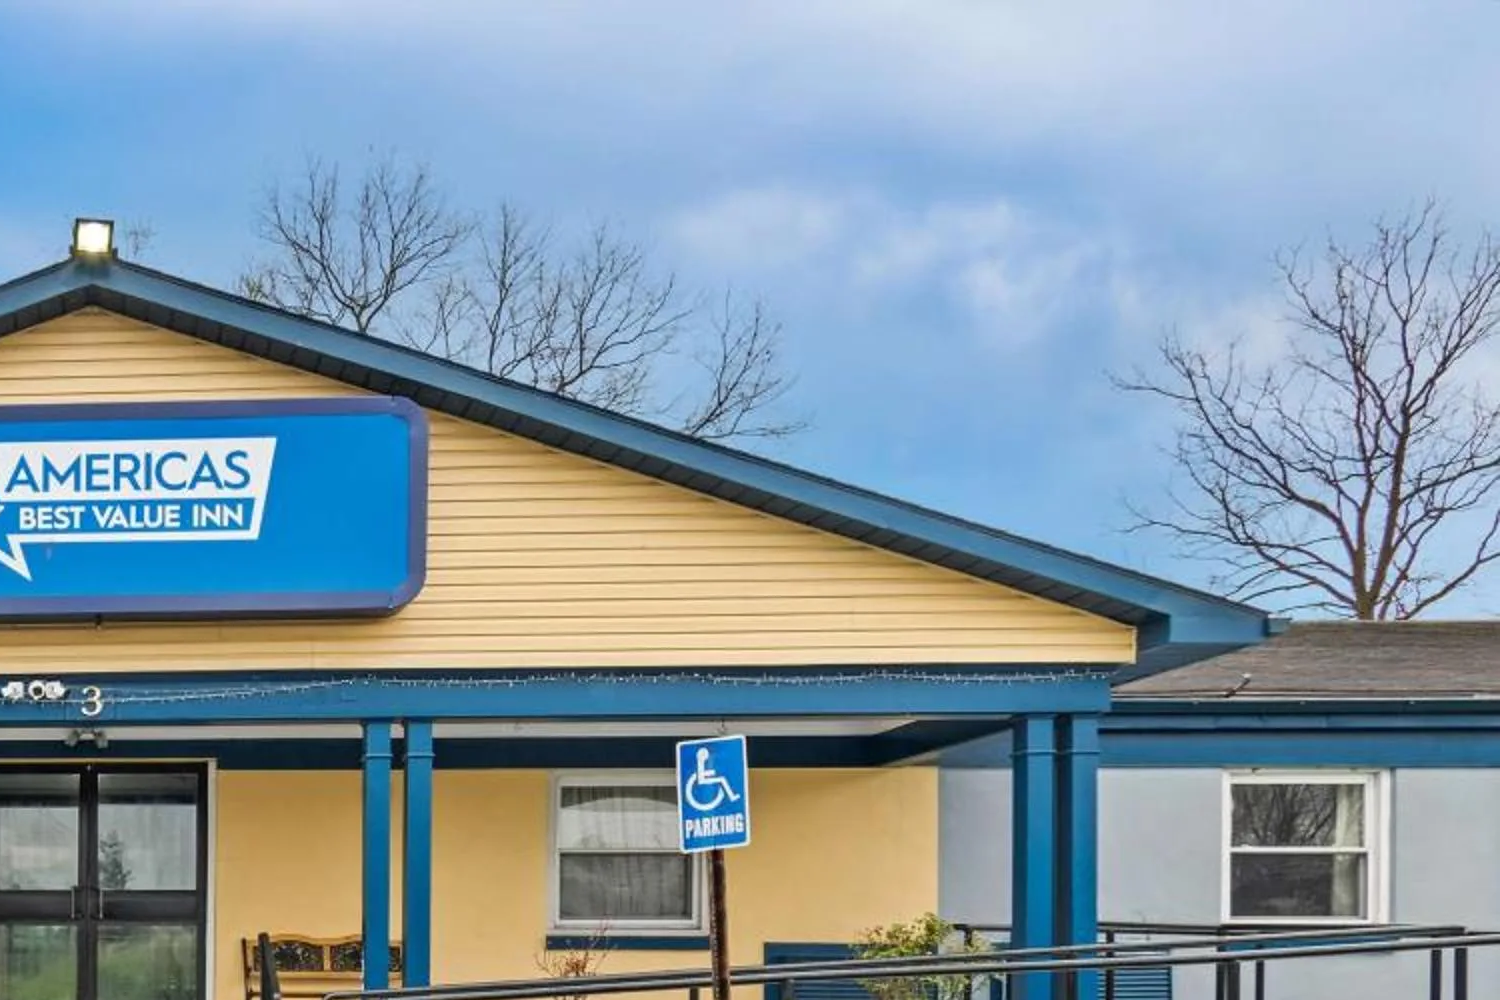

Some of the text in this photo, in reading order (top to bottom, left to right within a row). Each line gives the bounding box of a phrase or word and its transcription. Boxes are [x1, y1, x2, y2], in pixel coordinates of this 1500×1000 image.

[4, 449, 251, 492] AMERICAS
[19, 503, 244, 531] BEST VALUE INN
[81, 685, 103, 717] 3
[685, 812, 745, 840] PARKING
